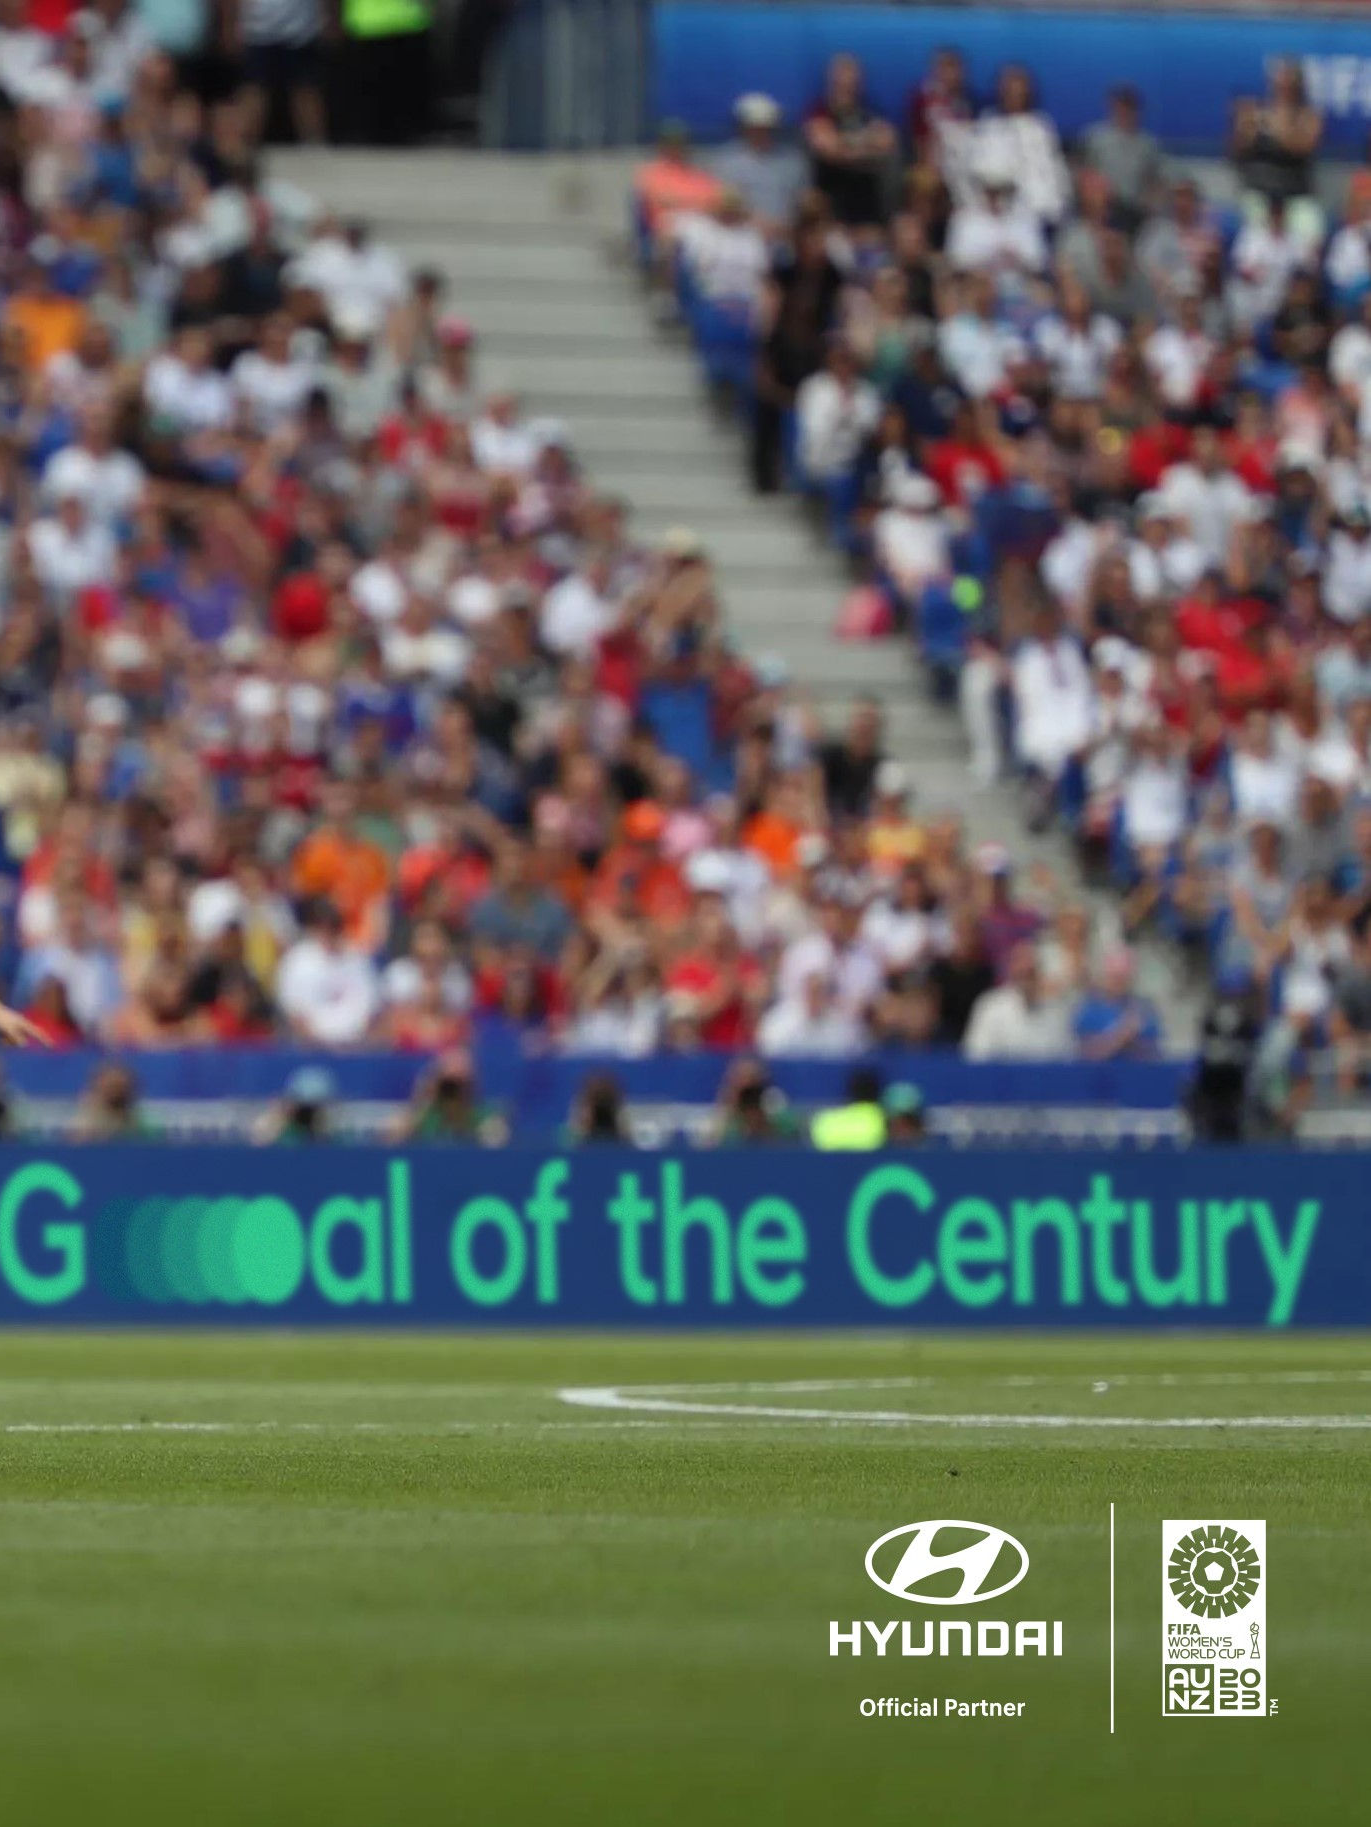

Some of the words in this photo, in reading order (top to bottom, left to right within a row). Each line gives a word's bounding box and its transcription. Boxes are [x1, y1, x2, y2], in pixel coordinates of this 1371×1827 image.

[451, 1160, 569, 1305] of
[608, 1160, 807, 1305] the
[844, 1164, 1319, 1326] Century
